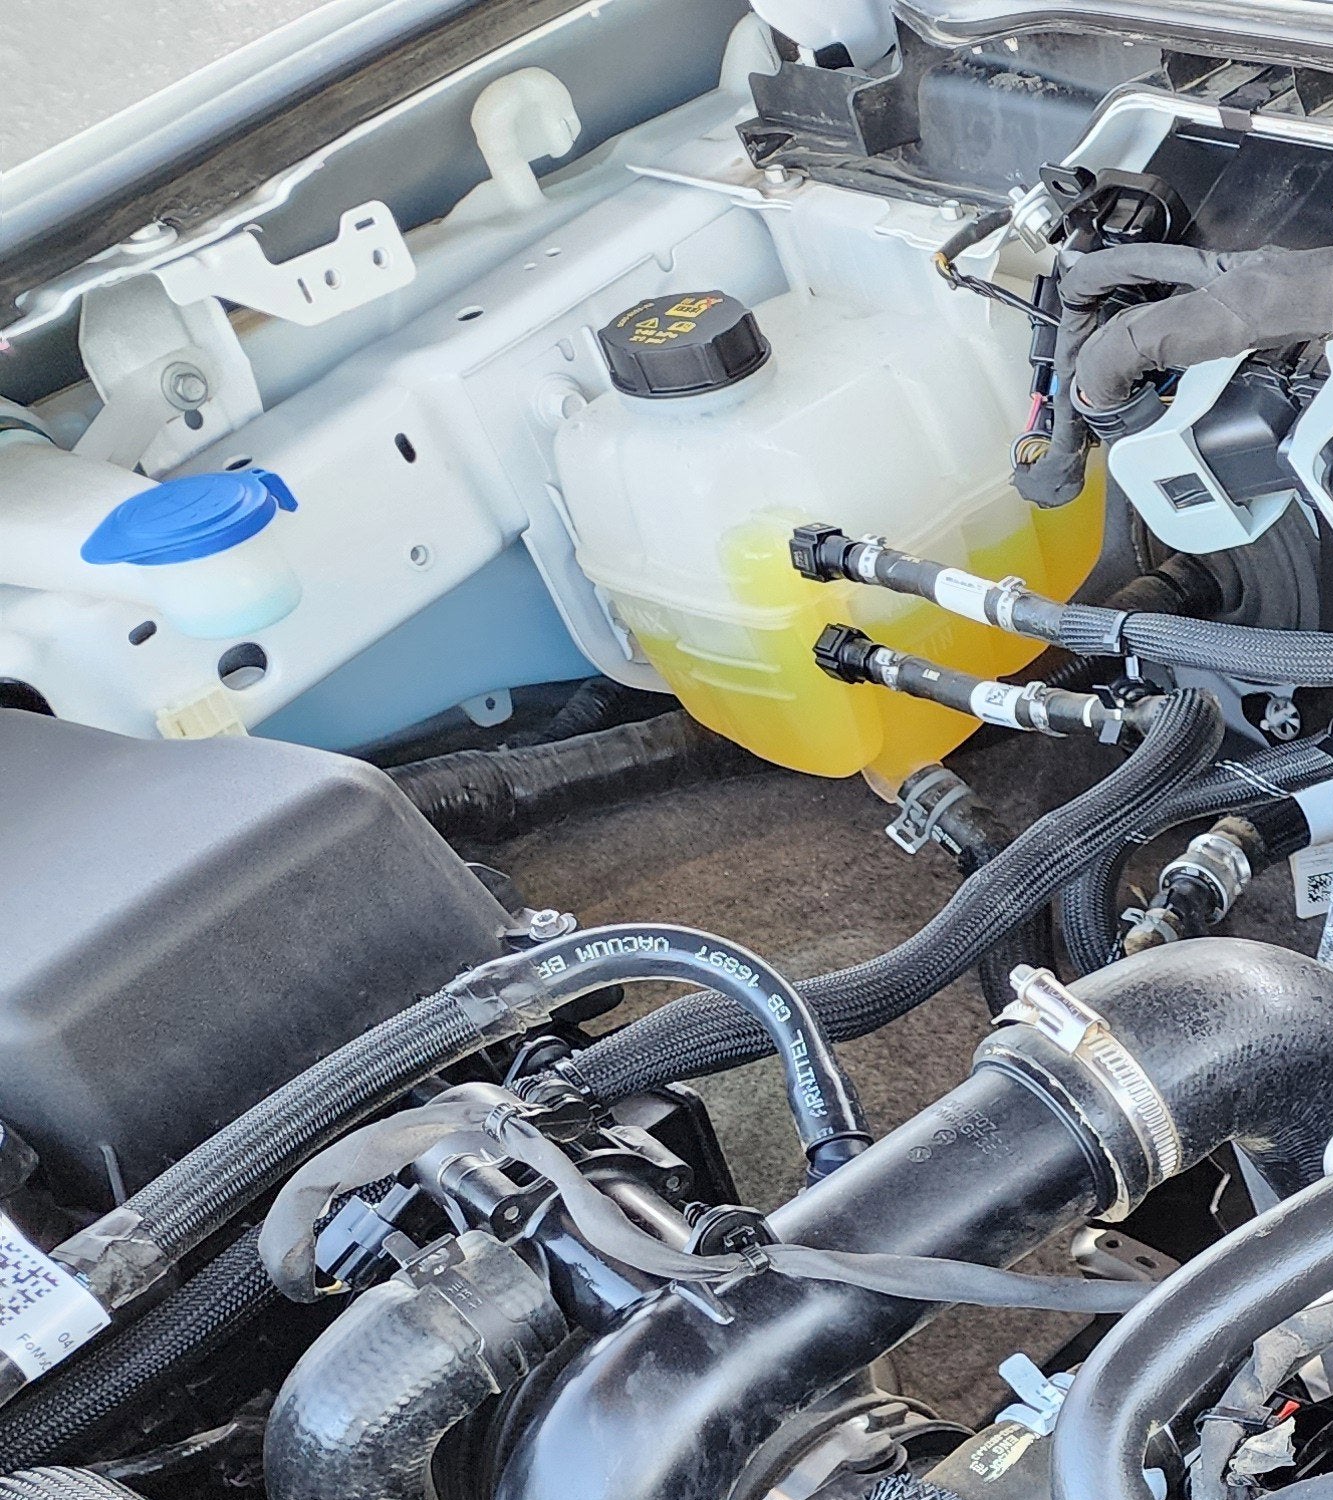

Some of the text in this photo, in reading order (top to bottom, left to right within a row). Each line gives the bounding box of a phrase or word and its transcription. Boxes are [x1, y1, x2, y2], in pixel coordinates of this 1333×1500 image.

[574, 935, 671, 964] VACUUM
[694, 945, 762, 990] 16897
[767, 992, 793, 1023] GB
